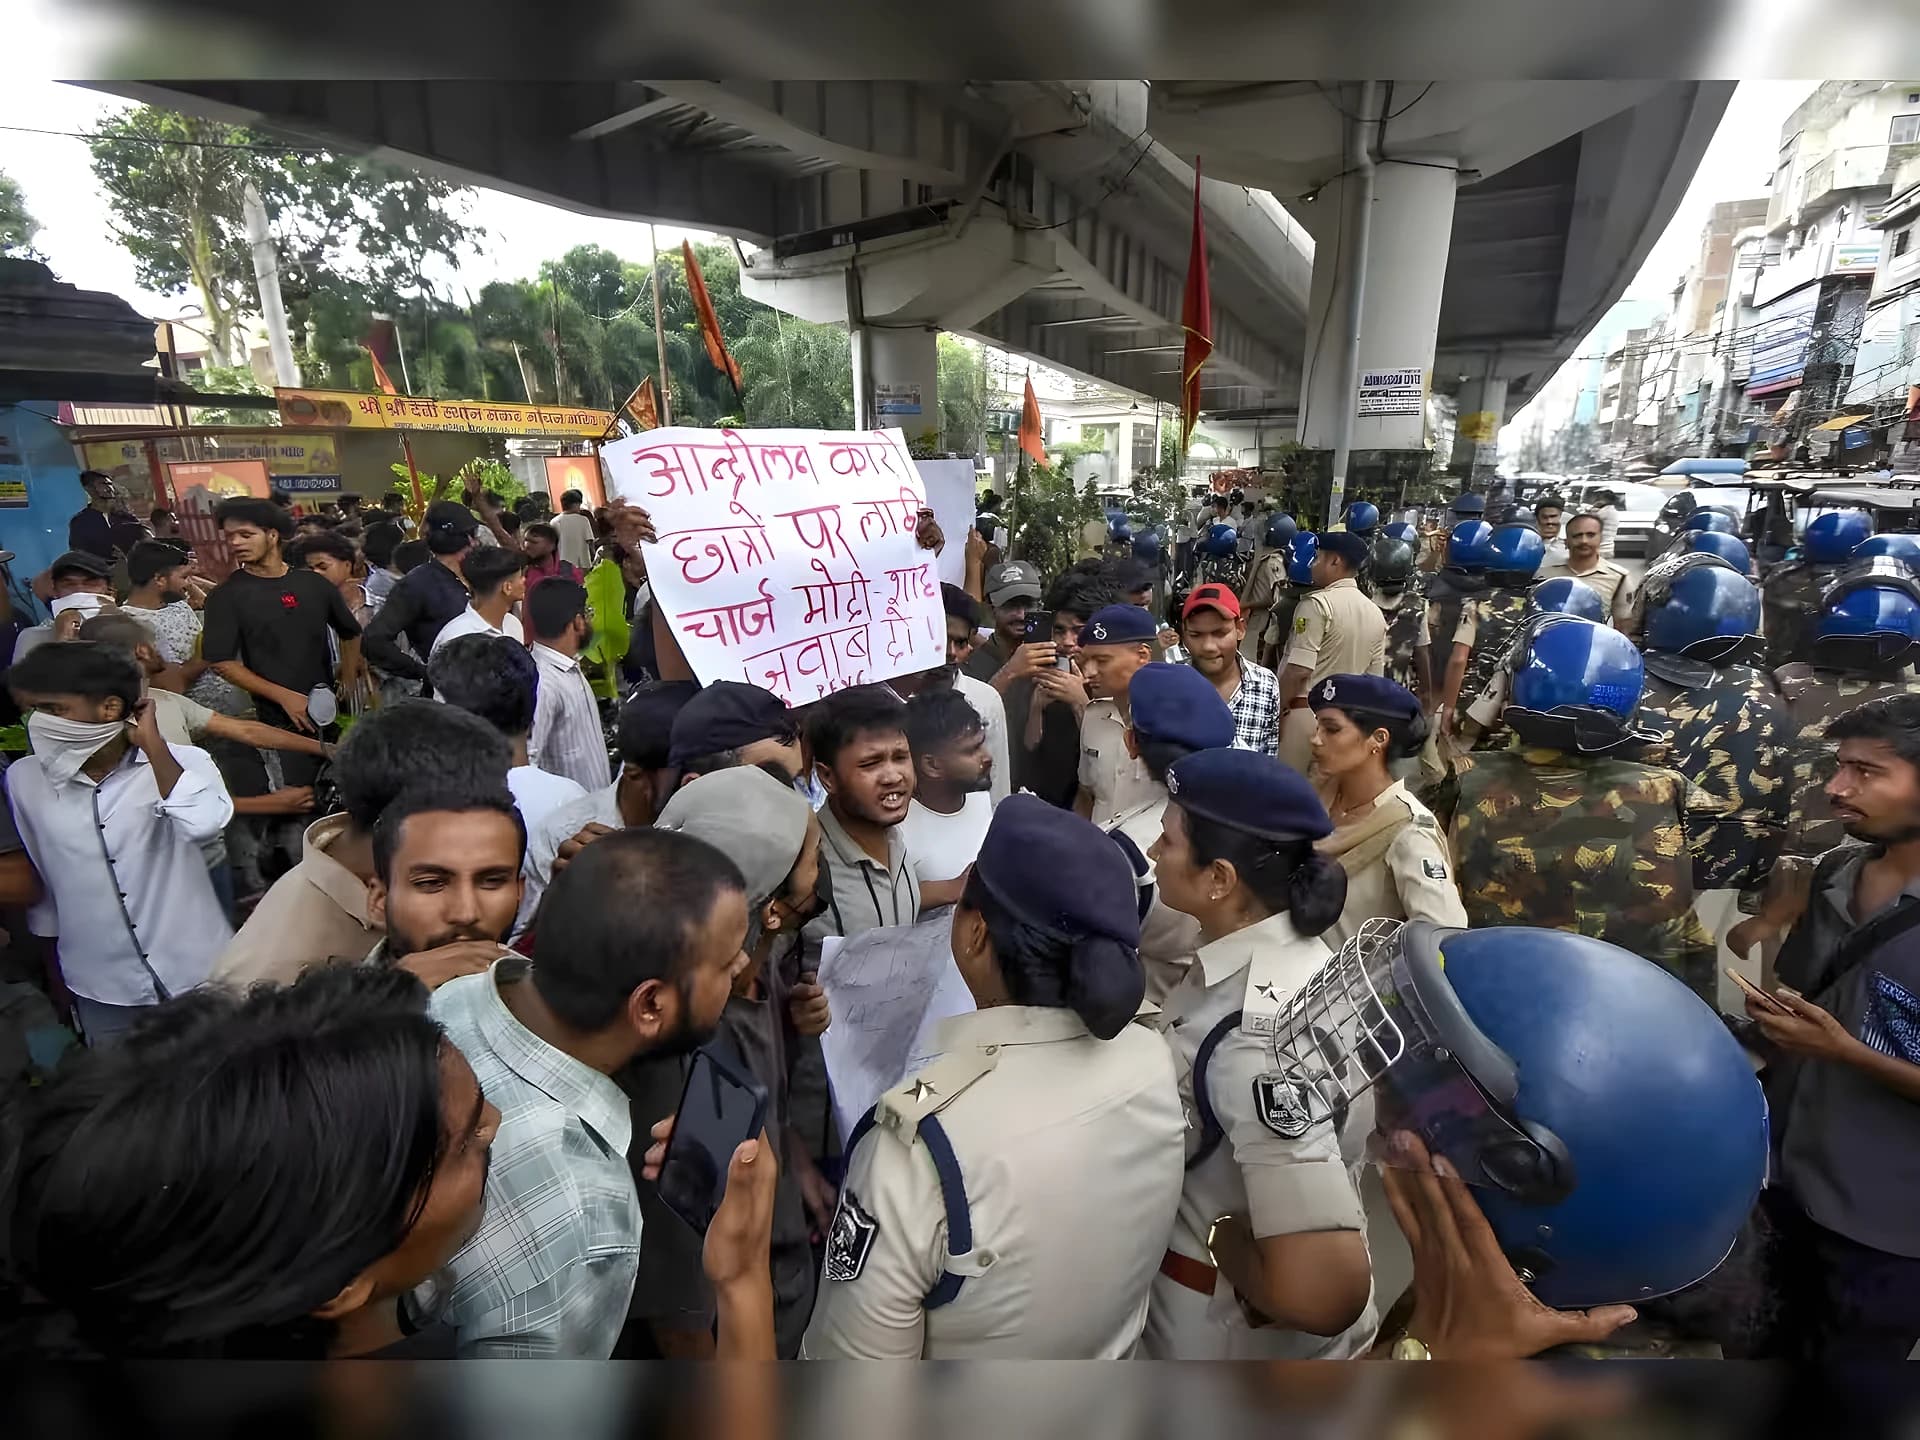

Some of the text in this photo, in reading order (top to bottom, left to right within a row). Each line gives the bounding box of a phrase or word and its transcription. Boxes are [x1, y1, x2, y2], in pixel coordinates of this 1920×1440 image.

[657, 500, 776, 584] छात्रों
[774, 504, 859, 569] पर
[676, 577, 776, 647] चार्ज
[742, 622, 873, 692] जवाब
